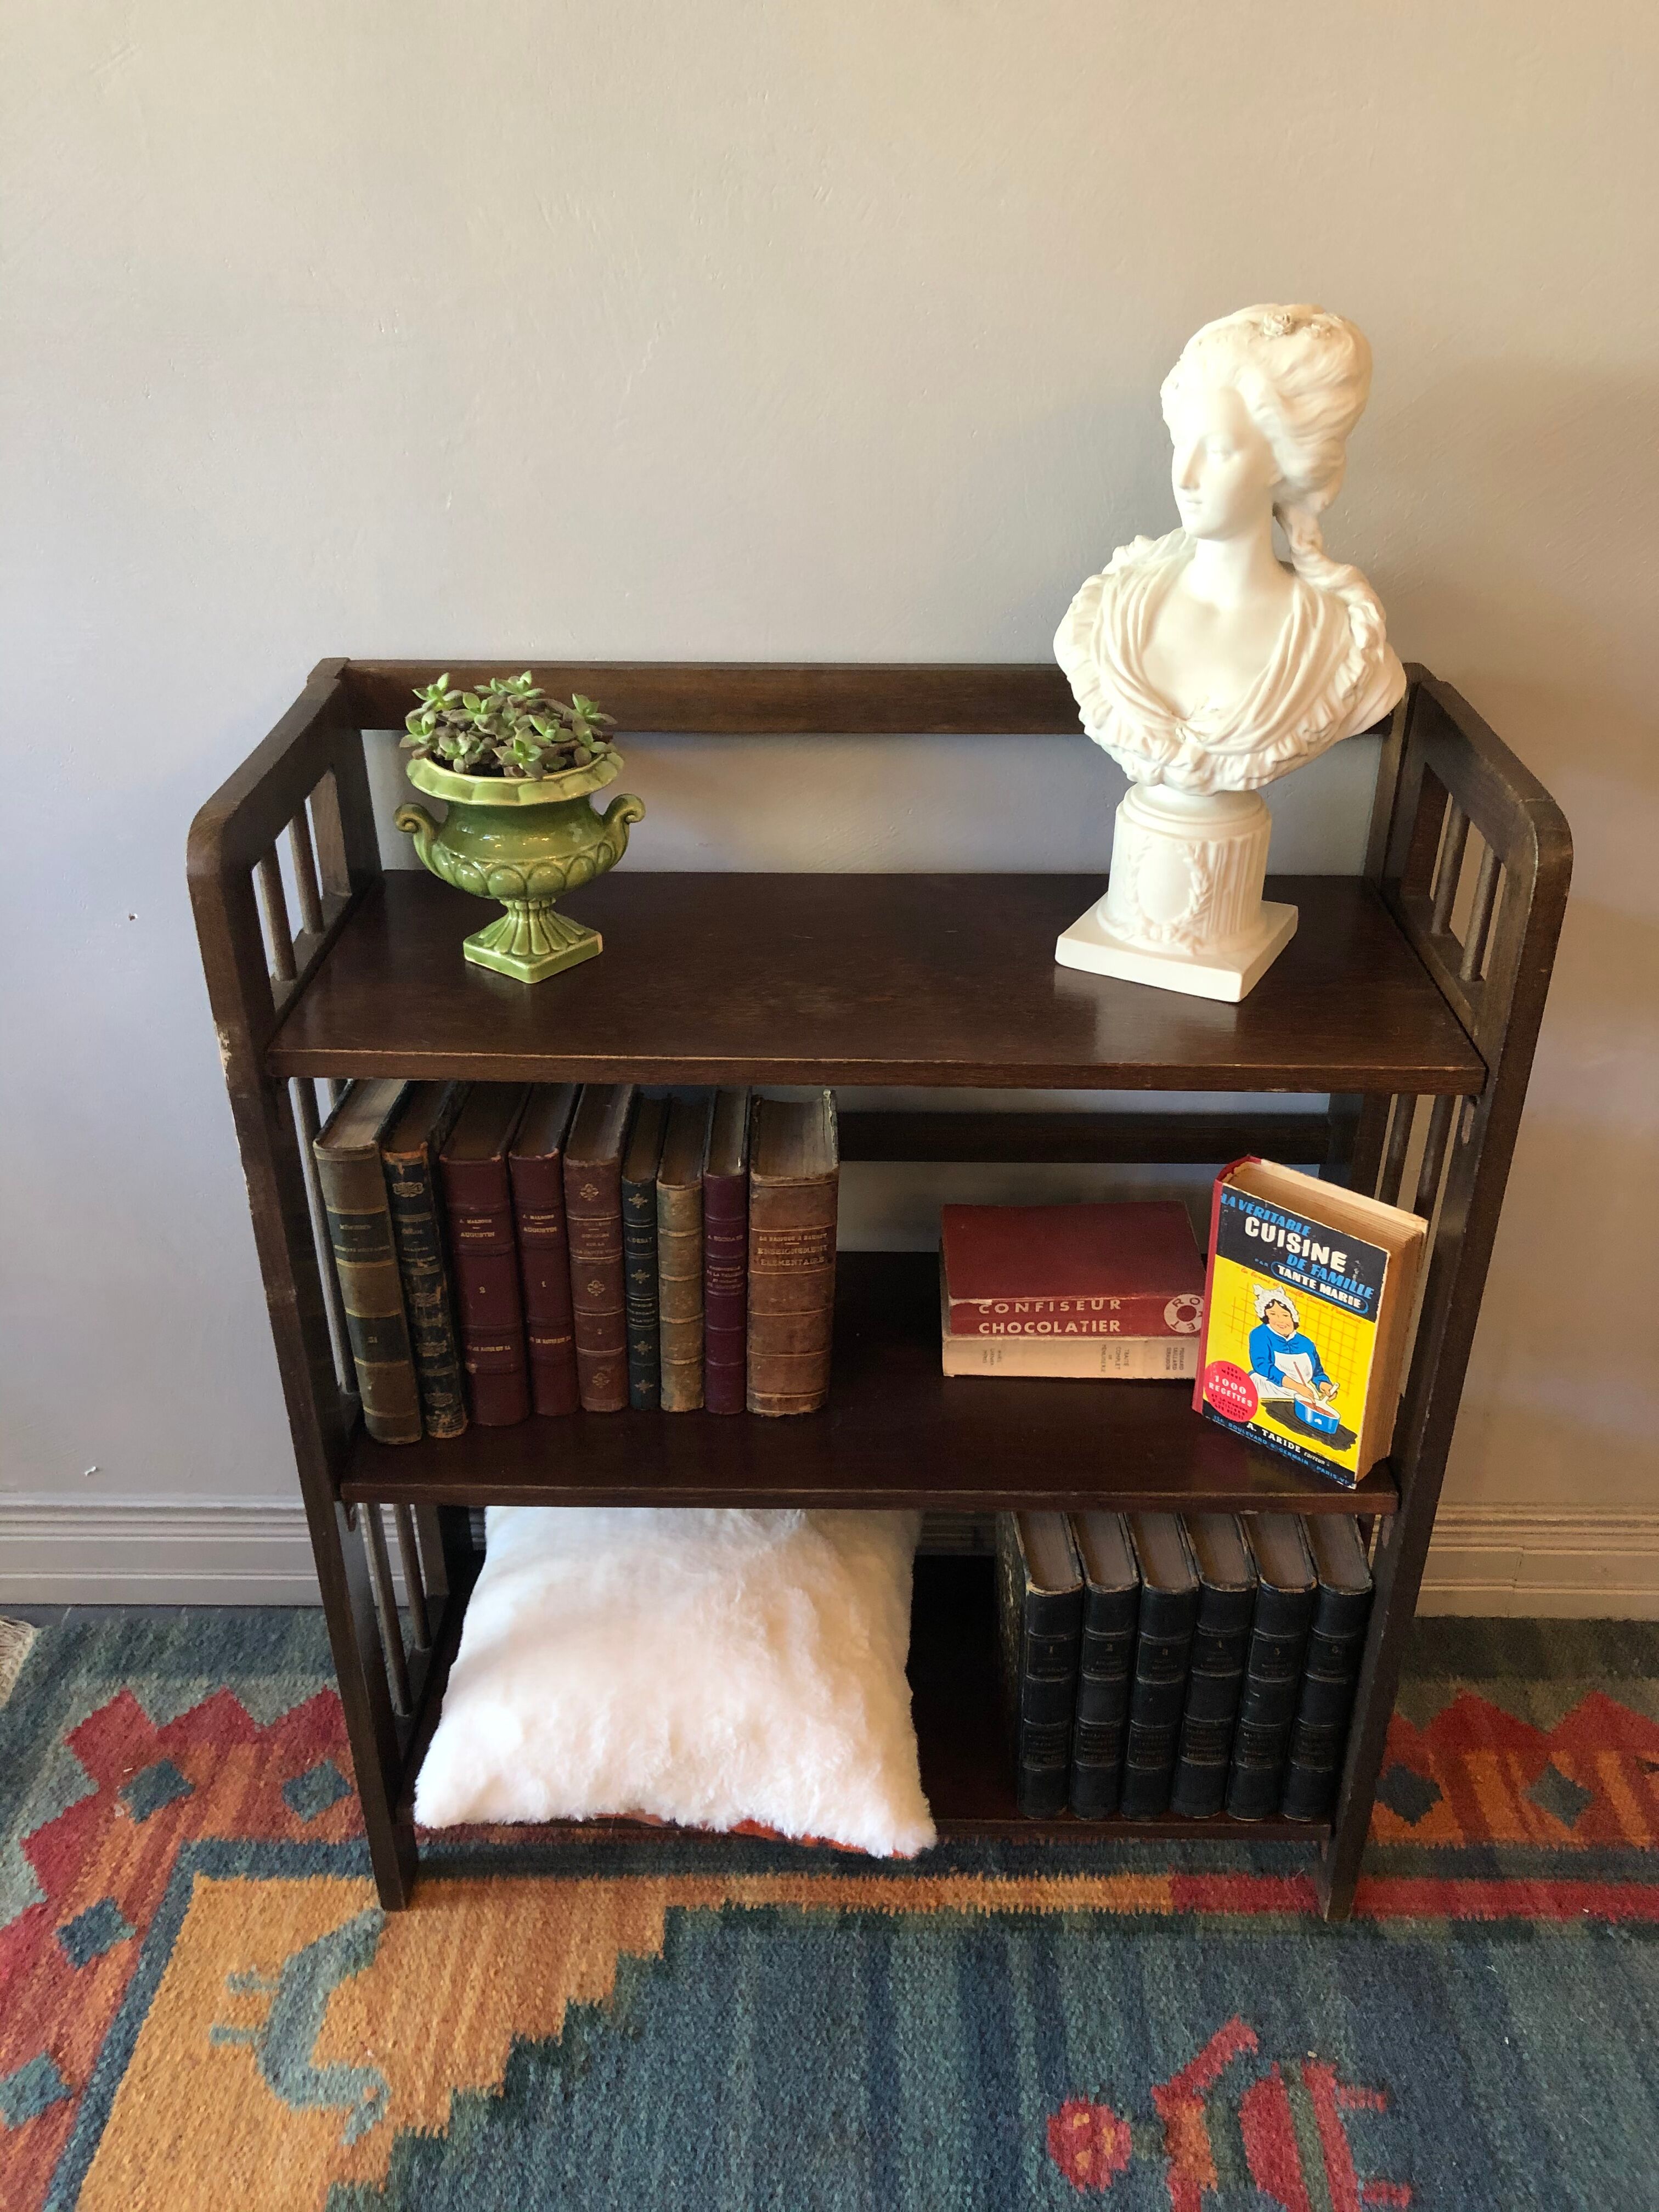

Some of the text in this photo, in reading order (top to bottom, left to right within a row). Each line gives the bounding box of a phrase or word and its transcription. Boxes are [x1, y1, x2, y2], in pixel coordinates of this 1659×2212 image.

[1221, 1193, 1312, 1237] LA VÉRITABLE
[1245, 1216, 1347, 1273] CUISINE
[1277, 1265, 1316, 1290] TANTE
[1319, 1285, 1361, 1308] MARIE
[1286, 1254, 1374, 1299] DE FAMILLE
[979, 1299, 1121, 1314] CONFISEUR
[979, 1320, 1121, 1334] CHOCOLATIER
[1209, 1382, 1252, 1407] RECETTES
[1215, 1375, 1246, 1395] 1000
[1228, 1423, 1267, 1444] BOULEVARD
[1279, 1447, 1308, 1466] GERMAIN
[1246, 1423, 1256, 1432] A.
[1262, 1429, 1301, 1453] TARIDE
